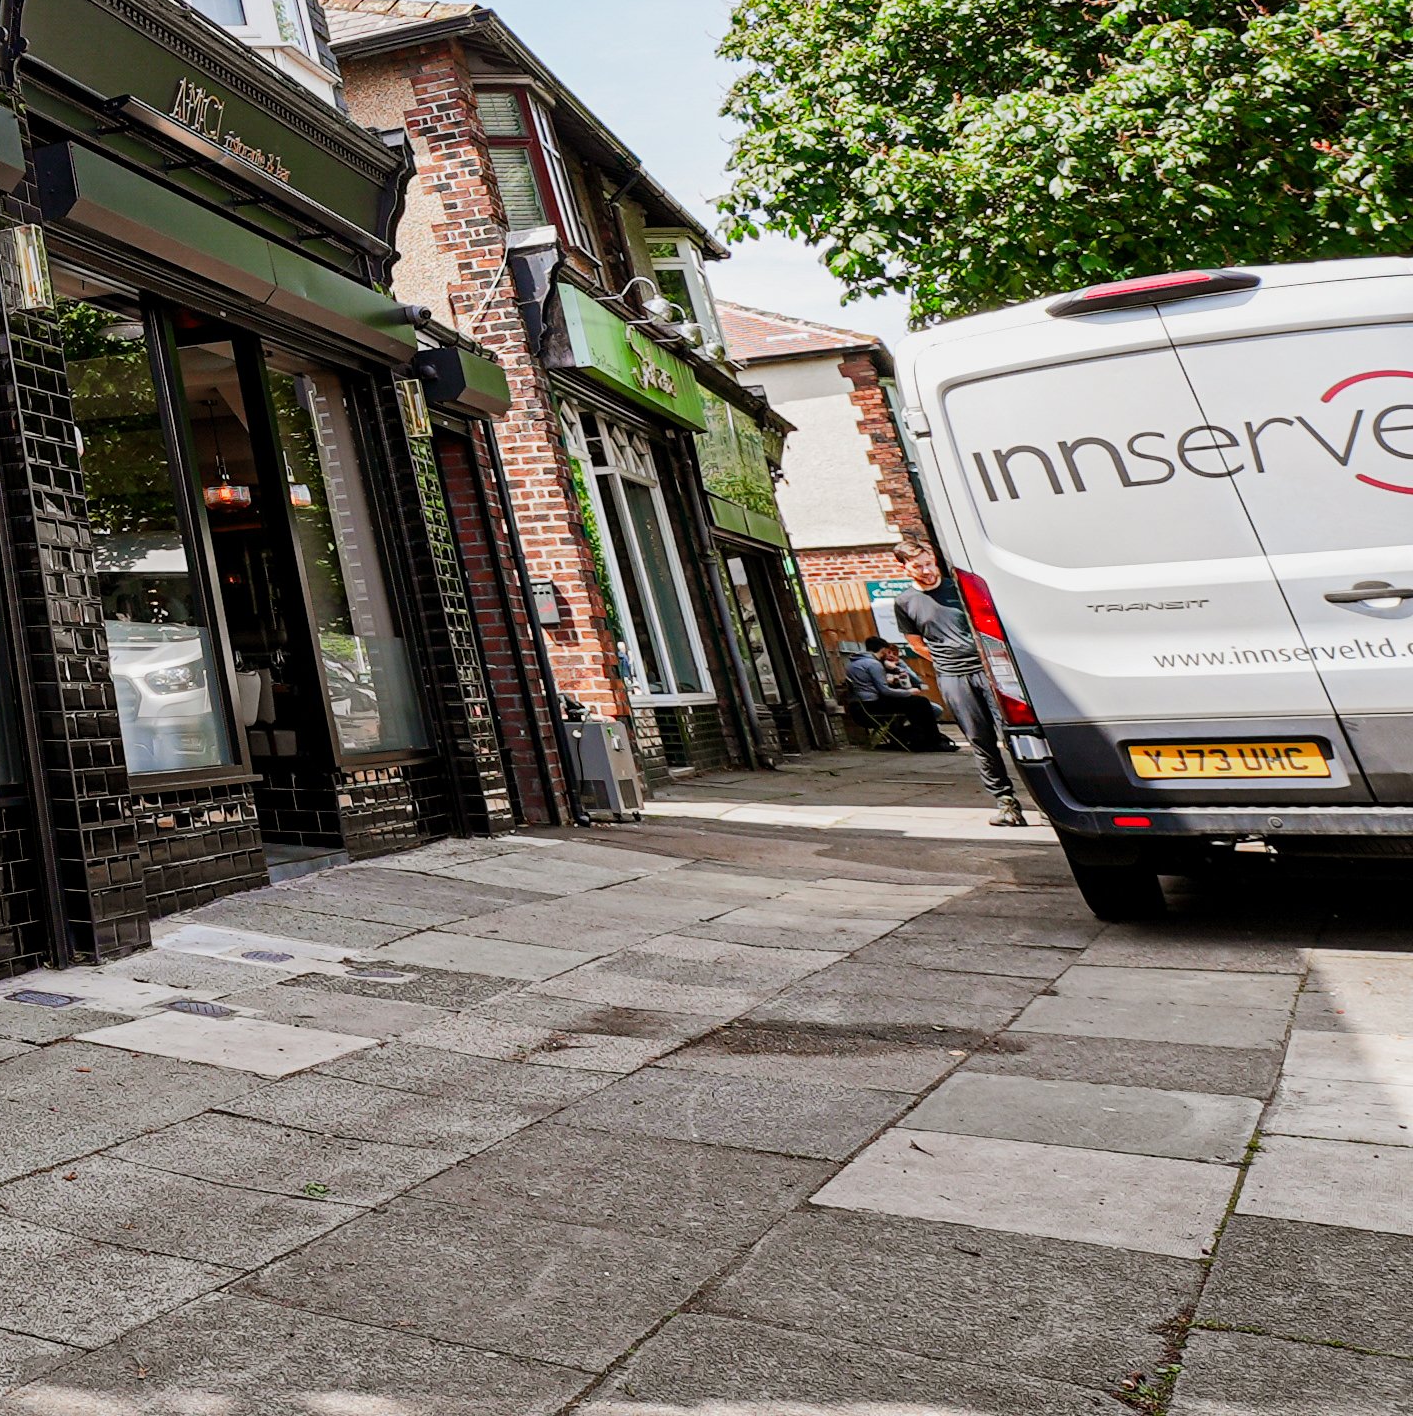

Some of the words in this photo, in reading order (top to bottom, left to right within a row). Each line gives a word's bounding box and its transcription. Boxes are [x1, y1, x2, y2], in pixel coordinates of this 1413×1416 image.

[168, 76, 226, 143] AMICI
[1085, 598, 1211, 613] TRANSIT
[1143, 747, 1233, 773] YJ73
[1236, 746, 1309, 772] UHC
